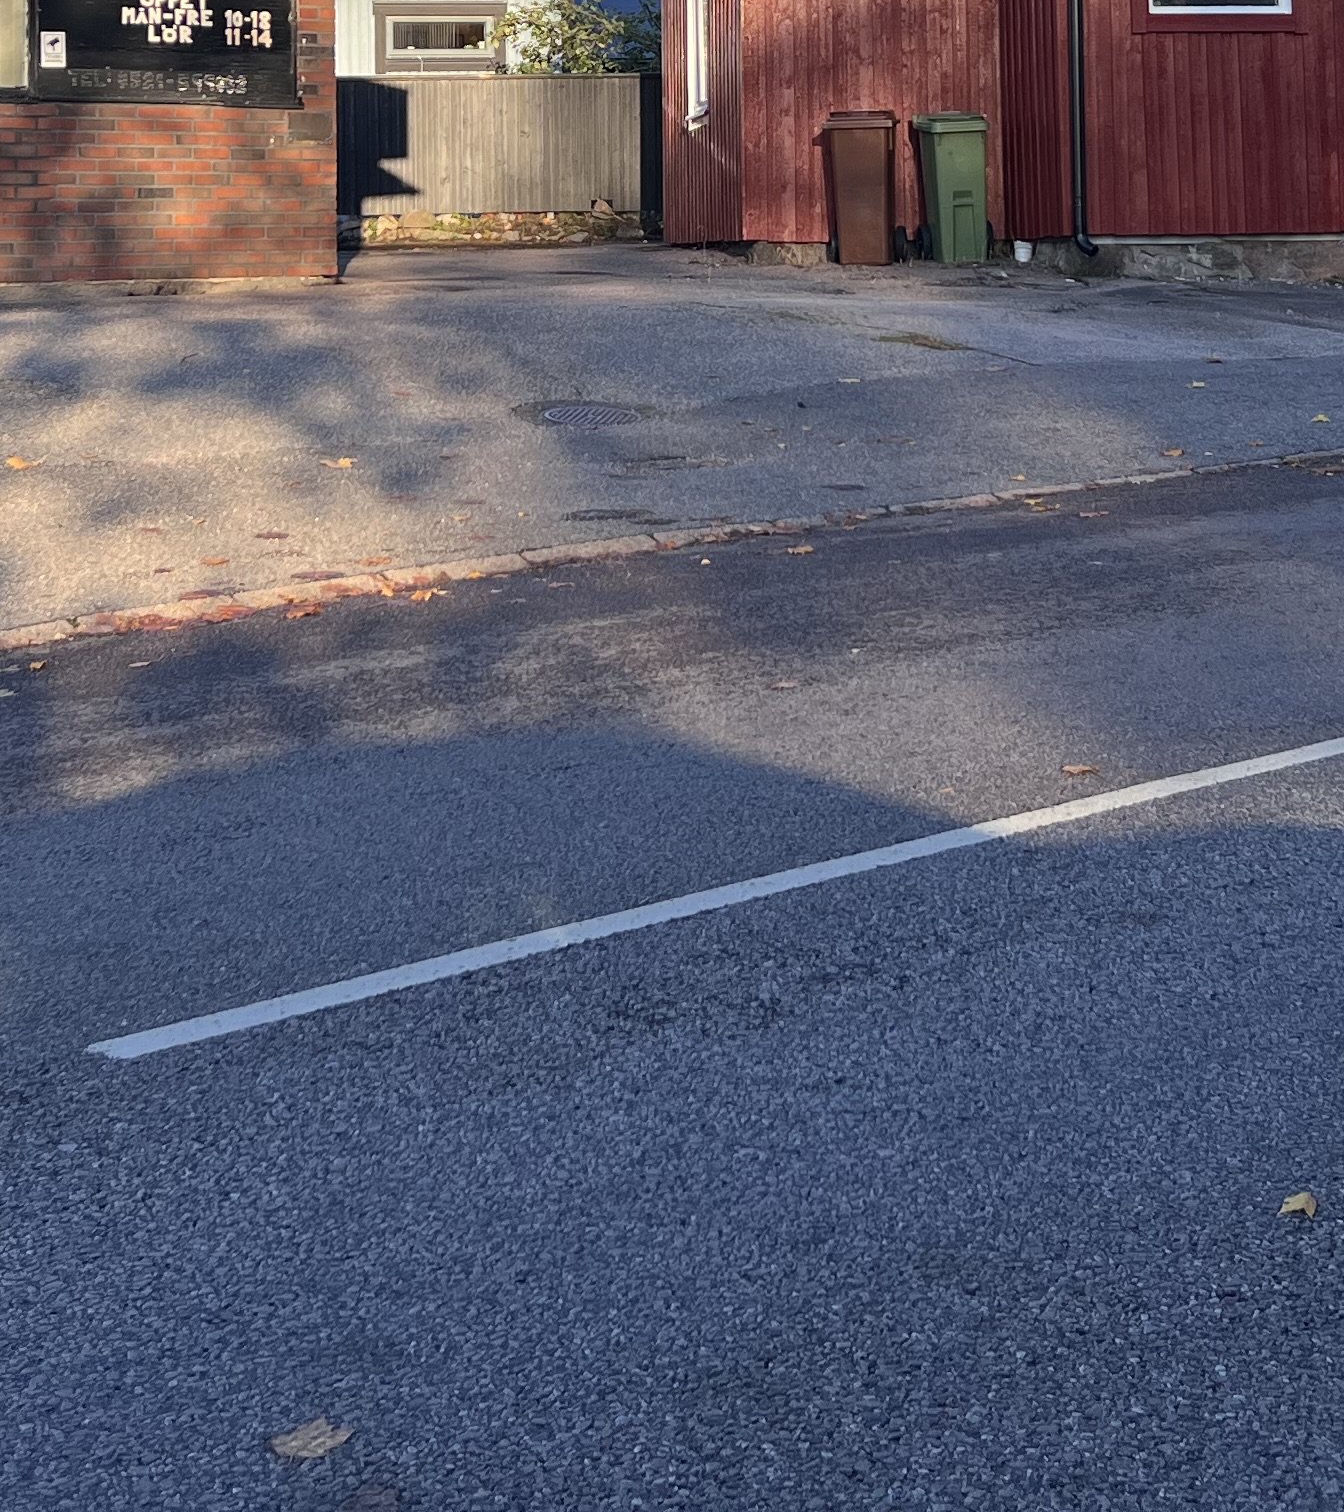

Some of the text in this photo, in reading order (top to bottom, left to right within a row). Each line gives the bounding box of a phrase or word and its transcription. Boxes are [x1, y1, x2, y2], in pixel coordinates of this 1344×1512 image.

[224, 9, 271, 30] 10-18
[147, 23, 272, 48] LÖR 11-14
